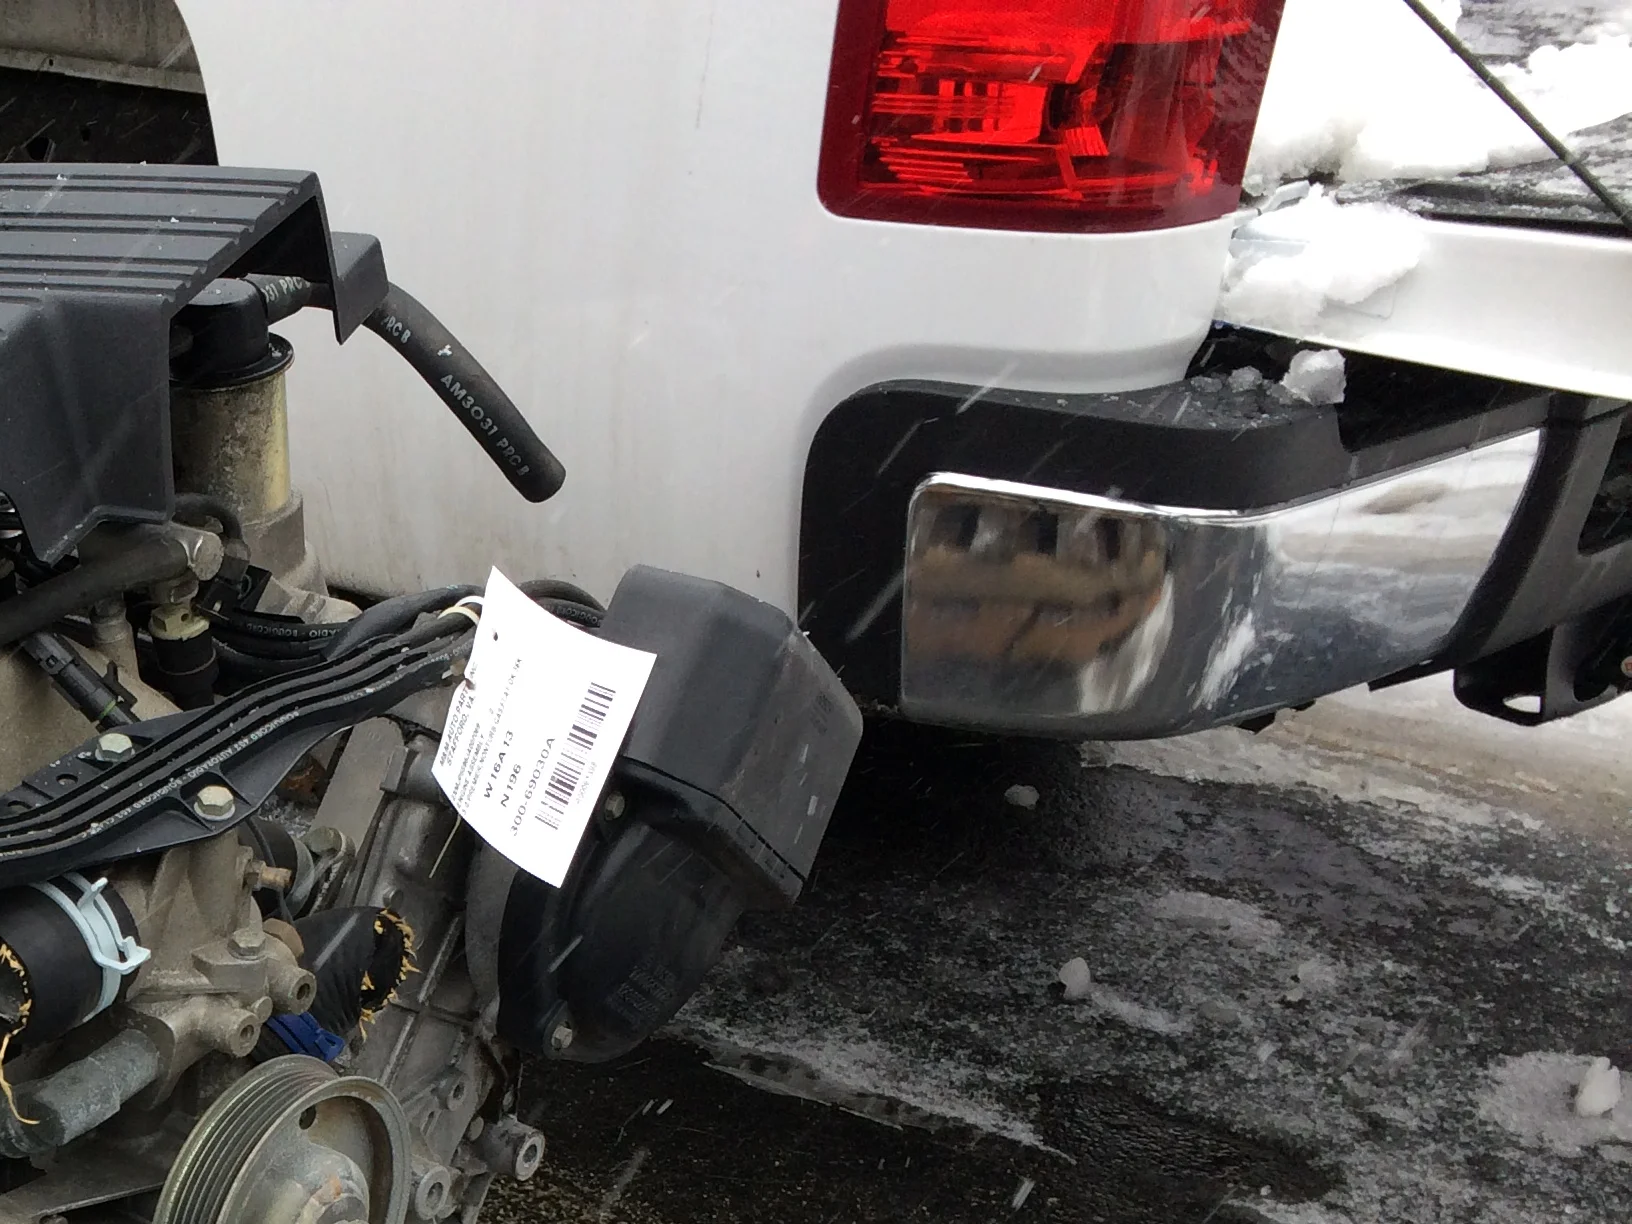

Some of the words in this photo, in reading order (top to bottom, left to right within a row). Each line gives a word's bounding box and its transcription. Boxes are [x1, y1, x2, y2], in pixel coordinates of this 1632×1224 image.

[440, 373, 498, 437] AM3031
[496, 437, 520, 467] PRC
[447, 714, 458, 741] AUTO
[508, 738, 555, 836] 300-69030A
